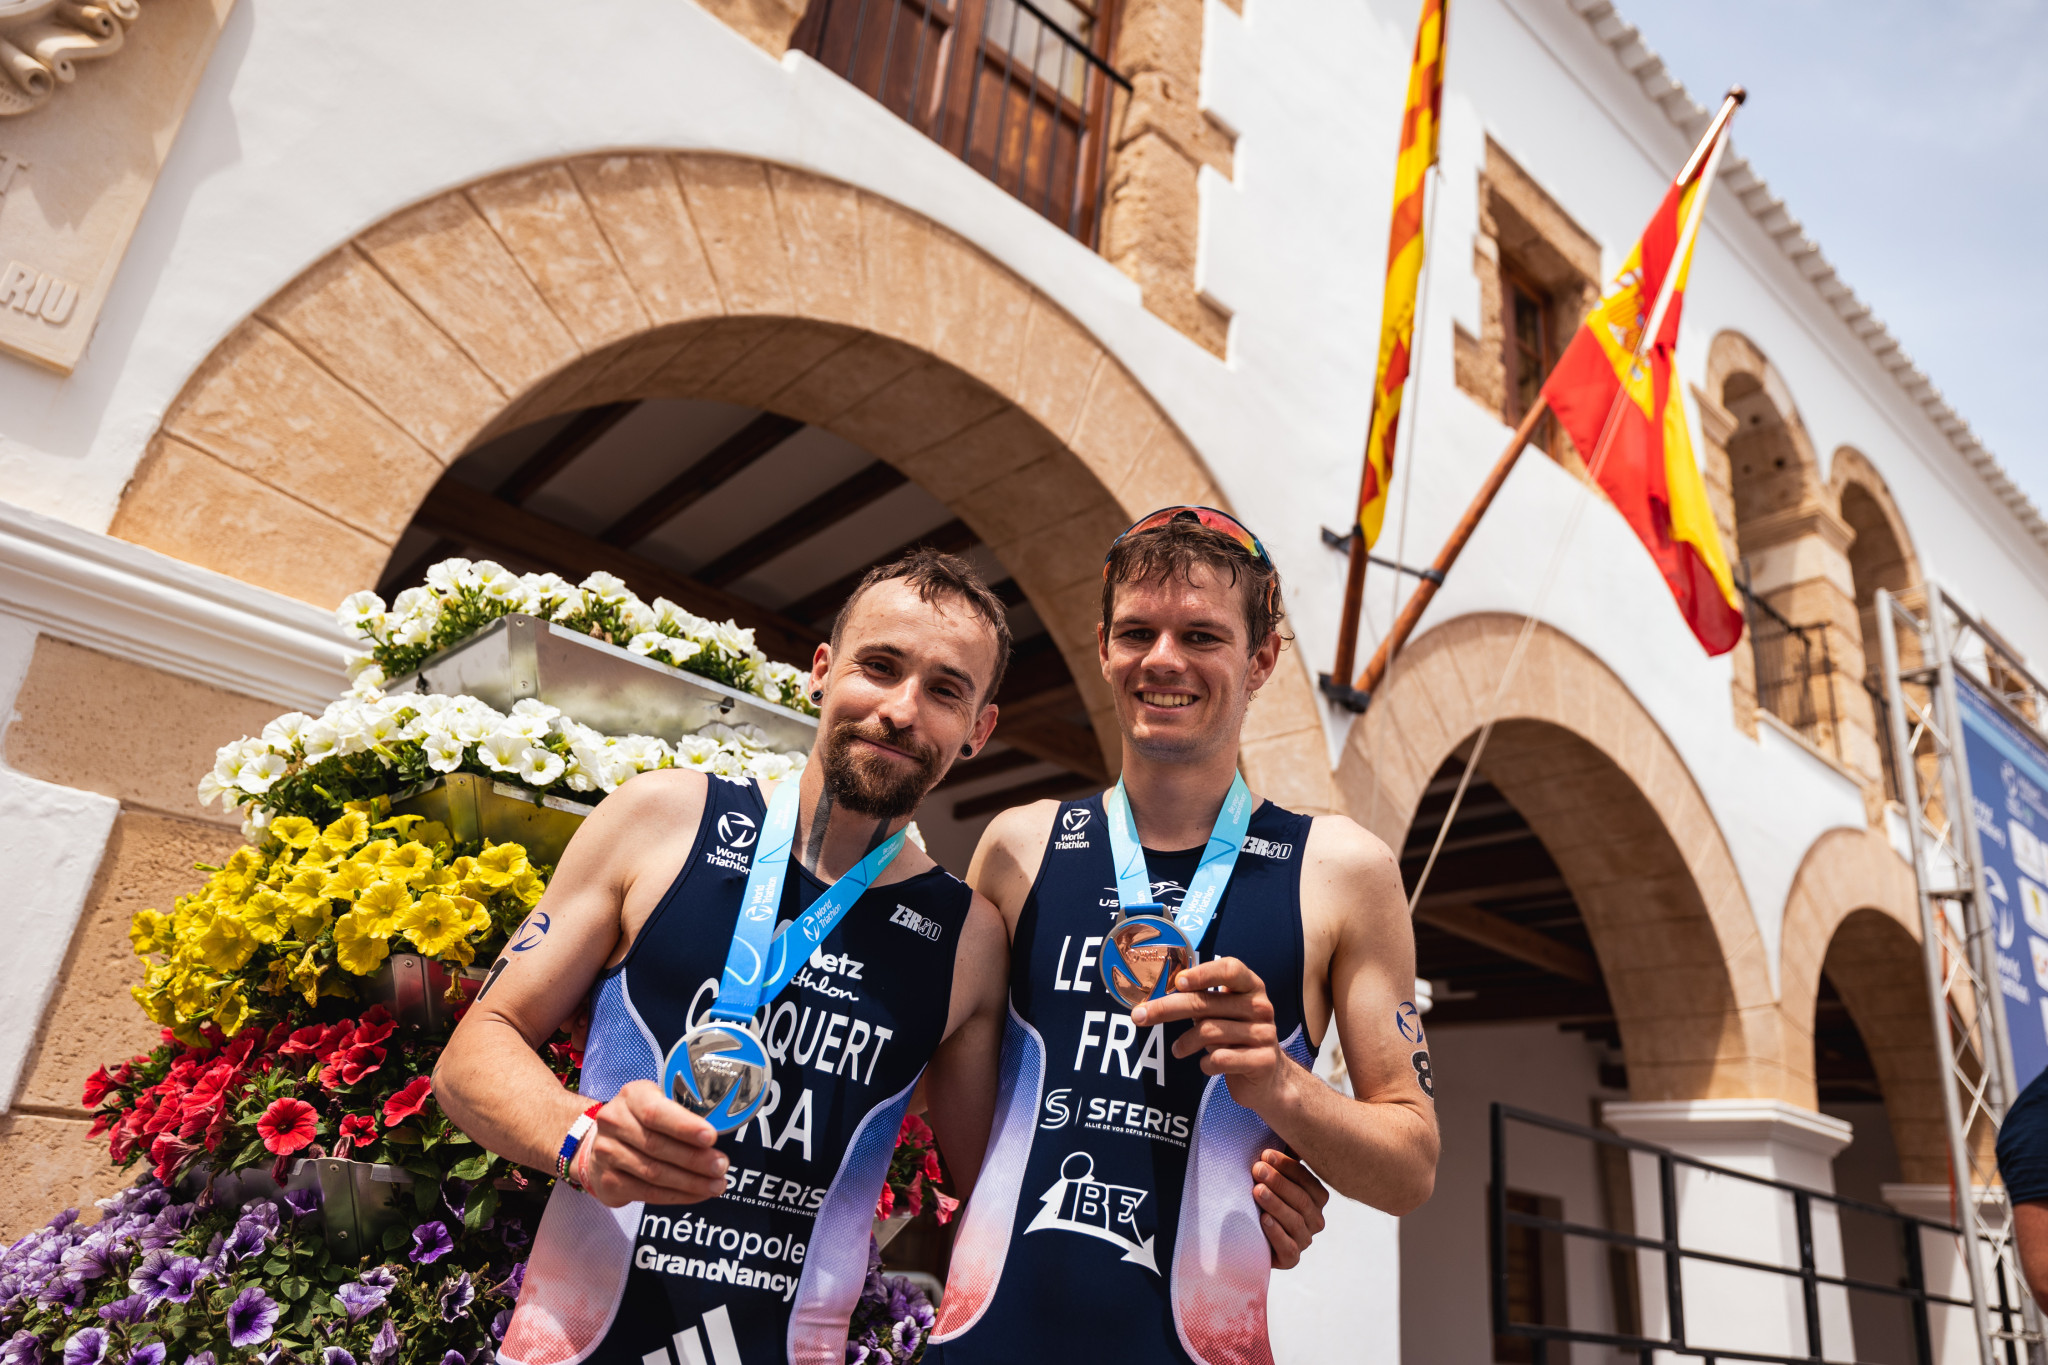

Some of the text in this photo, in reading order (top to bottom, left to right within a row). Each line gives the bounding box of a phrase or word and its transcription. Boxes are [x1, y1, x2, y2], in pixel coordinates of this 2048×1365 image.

[1054, 841, 1090, 850] Triathlon
[1061, 831, 1085, 841] World
[716, 845, 749, 865] World
[814, 899, 833, 919] World
[1186, 890, 1203, 913] World
[1195, 885, 1216, 914] Triathlon
[819, 904, 842, 928] Triathlon
[1054, 935, 1104, 993] LE
[1074, 1010, 1165, 1087] FRA
[1411, 1050, 1434, 1100] 8
[640, 1212, 806, 1265] métropole
[635, 1244, 799, 1303] GrandNancy
